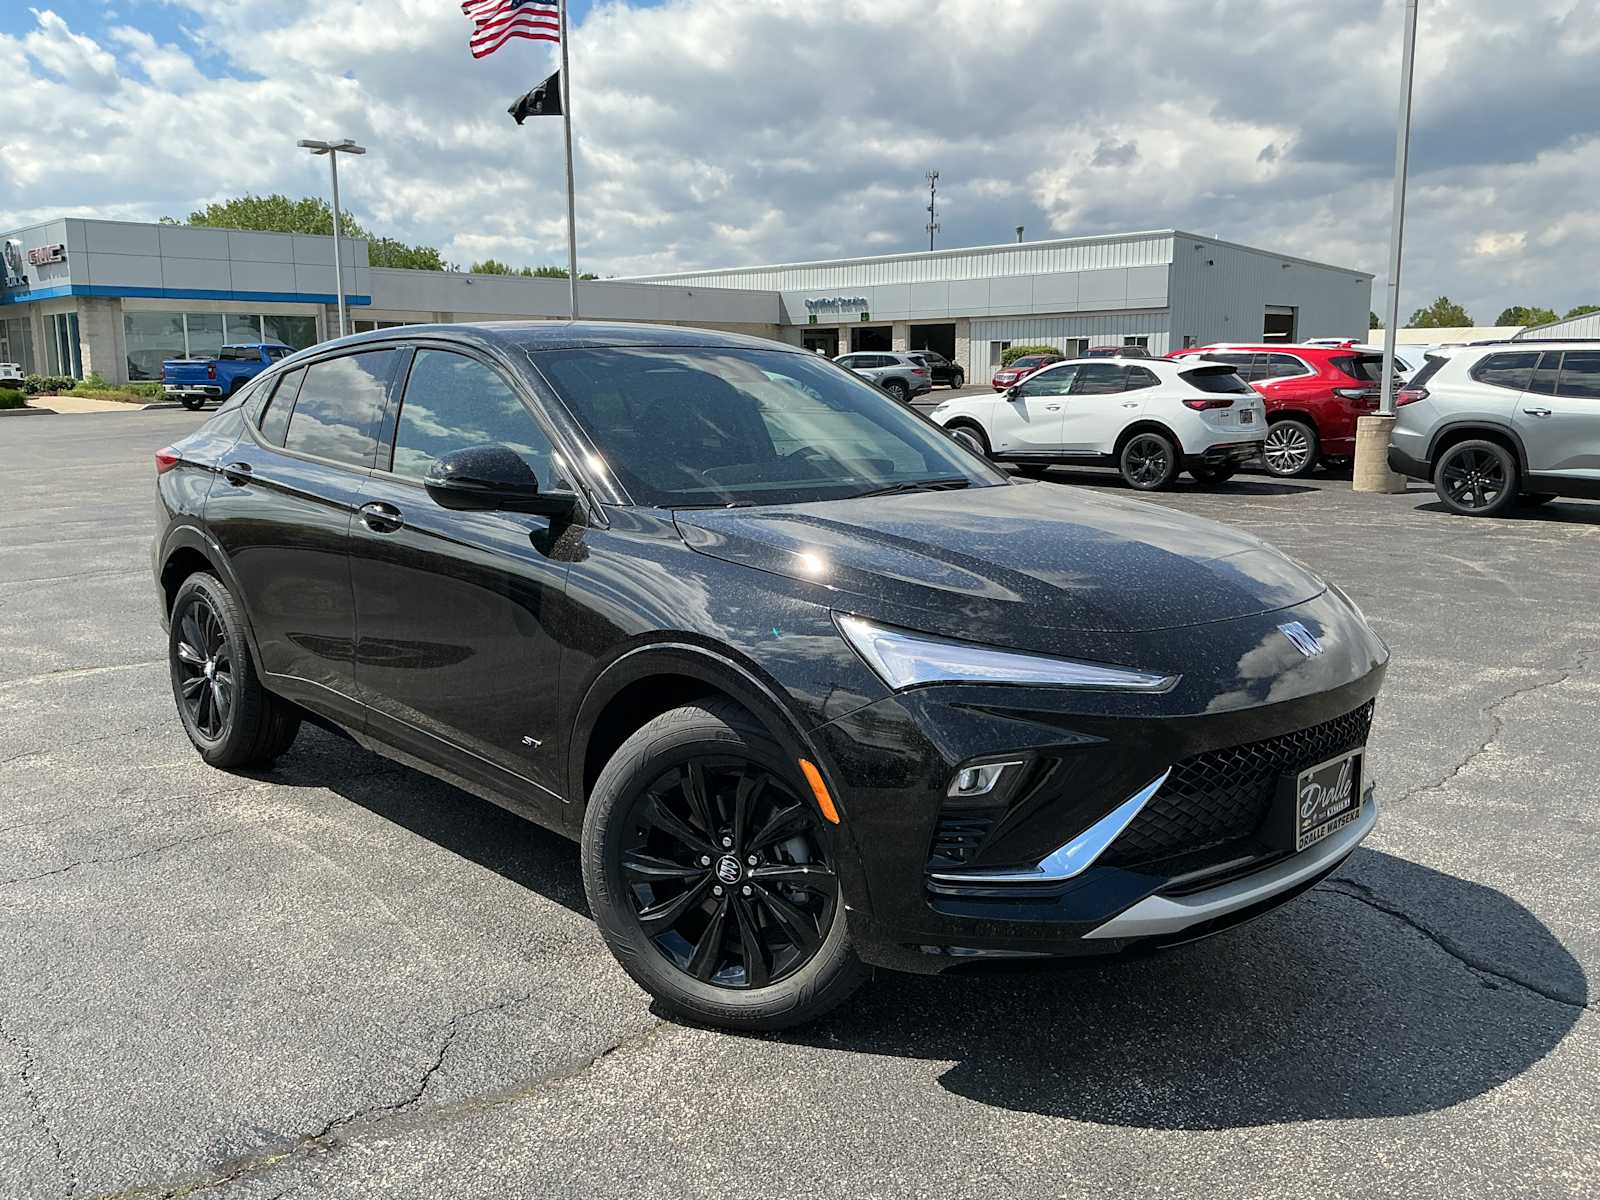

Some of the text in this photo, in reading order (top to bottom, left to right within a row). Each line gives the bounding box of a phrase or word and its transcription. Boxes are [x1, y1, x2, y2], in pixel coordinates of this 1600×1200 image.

[28, 244, 65, 266] GMC
[521, 735, 542, 749] ST
[1300, 758, 1353, 818] Dralle
[1299, 809, 1360, 849] DRALLE WATSEKA
